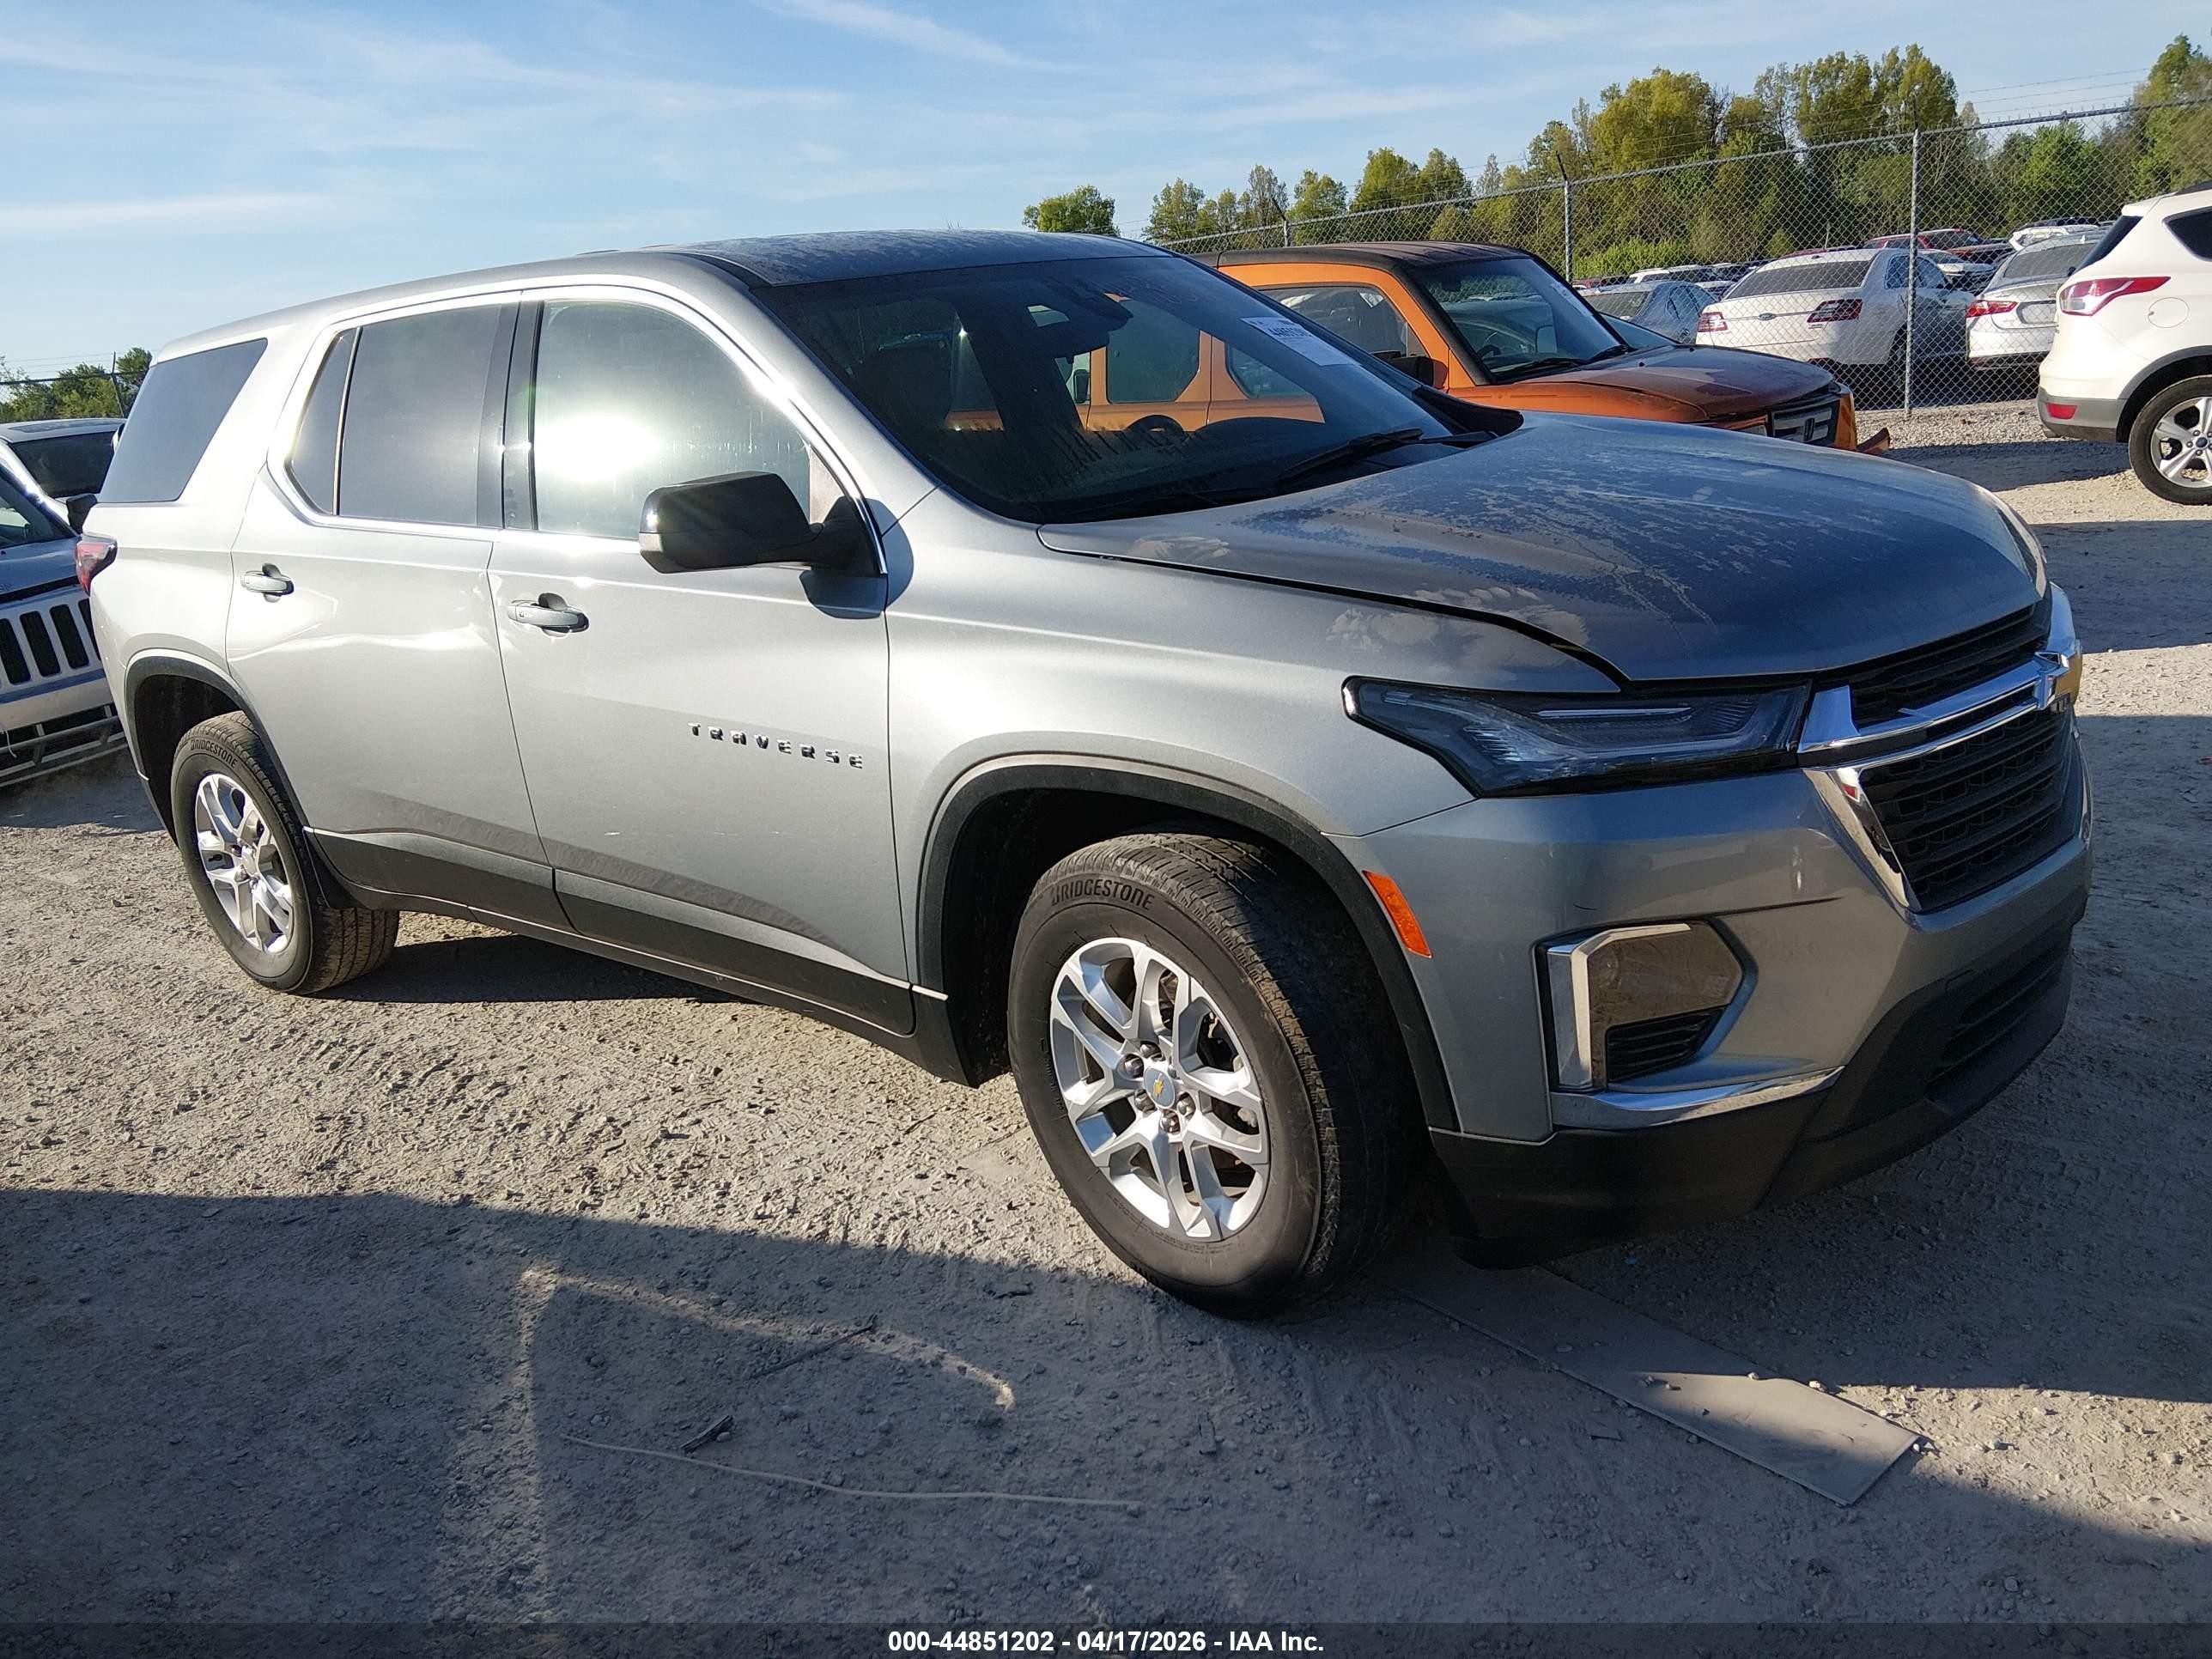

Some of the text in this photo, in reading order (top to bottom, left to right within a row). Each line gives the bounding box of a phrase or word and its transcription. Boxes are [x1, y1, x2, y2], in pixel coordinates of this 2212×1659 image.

[191, 738, 238, 769] BRIDGESTONE
[688, 722, 863, 769] TRAVERSE
[1051, 878, 1155, 911] BRIDGESTONE
